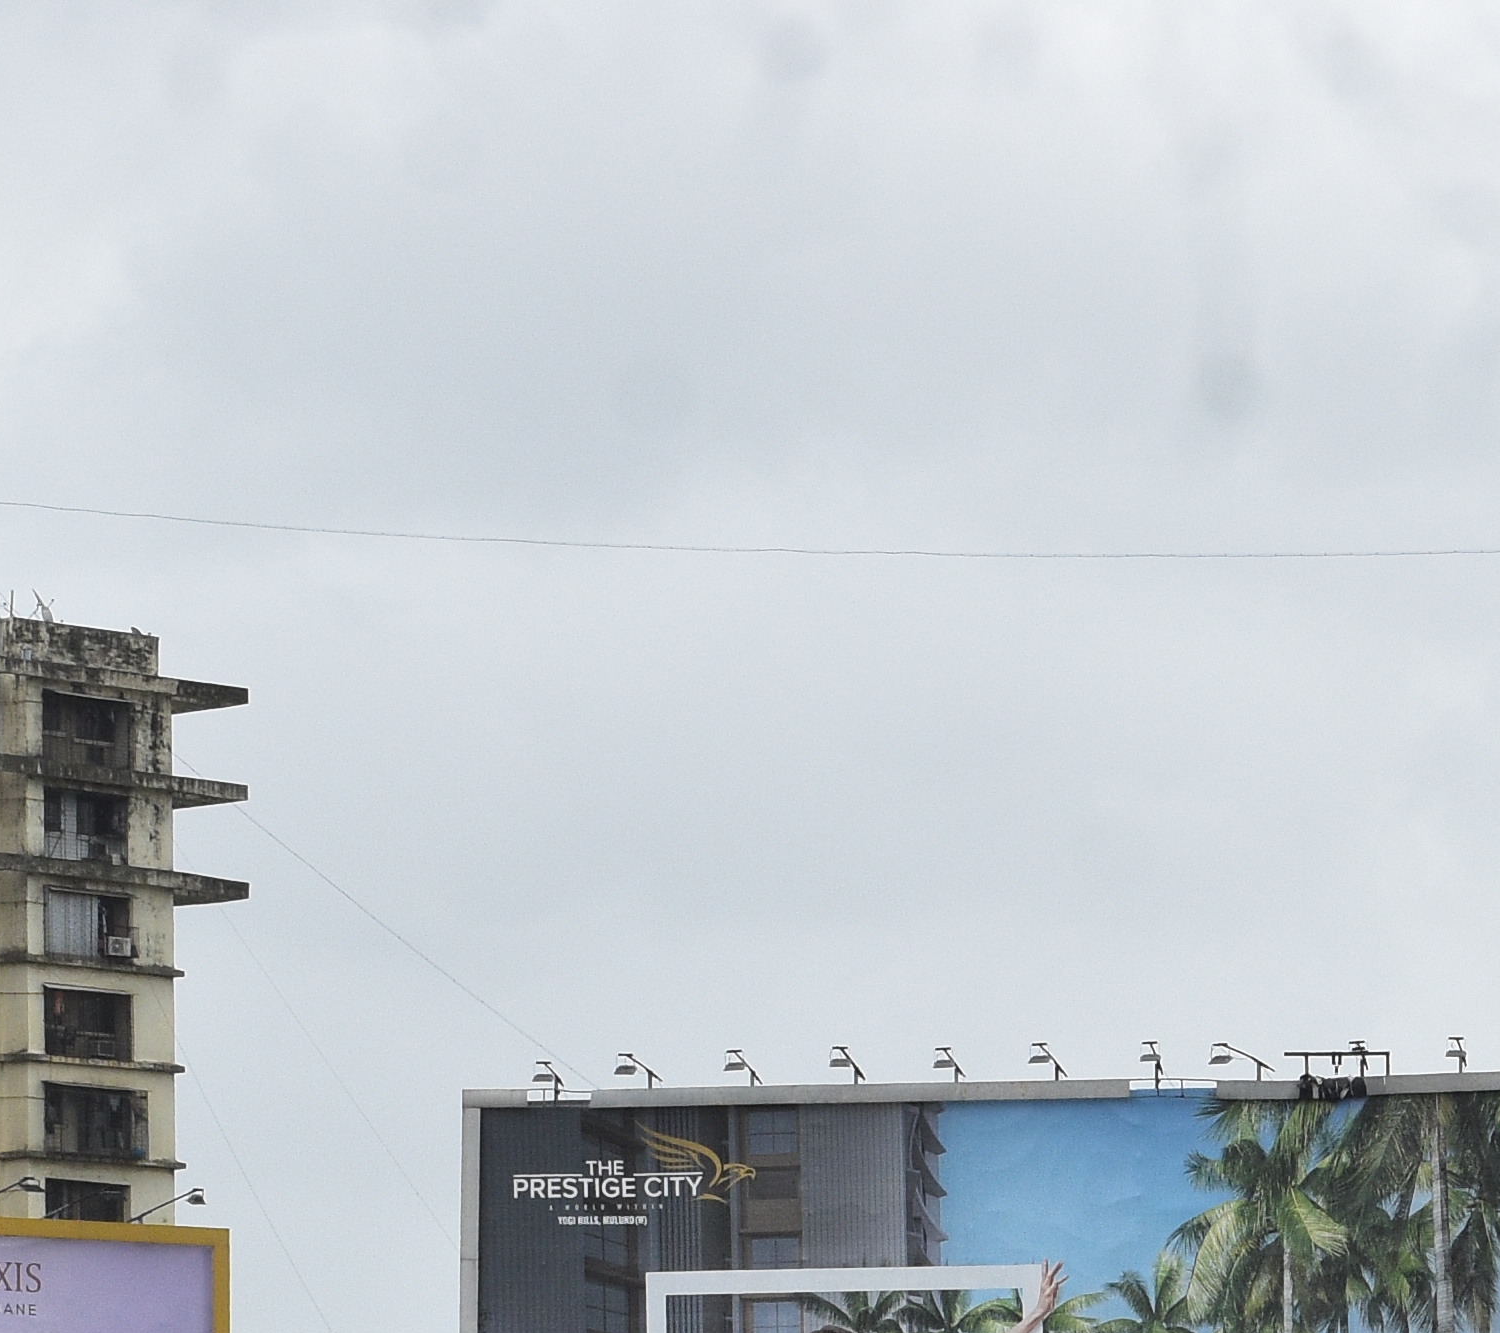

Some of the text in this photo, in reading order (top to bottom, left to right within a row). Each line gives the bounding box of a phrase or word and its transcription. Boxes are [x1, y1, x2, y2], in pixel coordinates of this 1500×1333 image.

[586, 1160, 624, 1176] THE
[513, 1175, 703, 1199] PRESTIGE CITY
